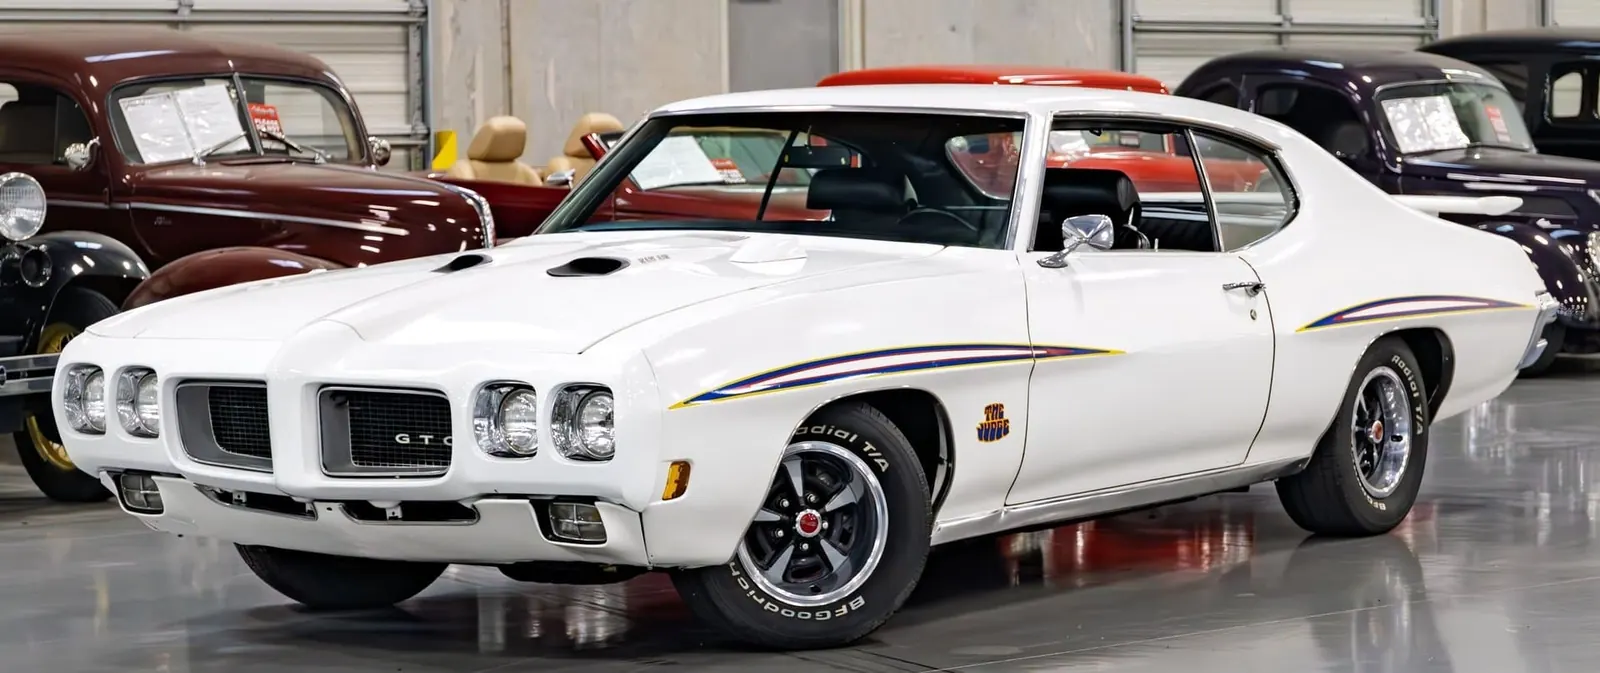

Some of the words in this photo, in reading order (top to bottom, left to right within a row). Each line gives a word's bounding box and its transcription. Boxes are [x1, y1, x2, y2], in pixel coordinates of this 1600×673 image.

[984, 403, 1004, 421] THE
[1391, 354, 1420, 398] Radial
[1415, 404, 1424, 435] T/A
[794, 424, 859, 443] adial
[863, 441, 889, 473] T/A
[976, 419, 1010, 442] JUDGE
[728, 561, 865, 621] BFGoodrich
